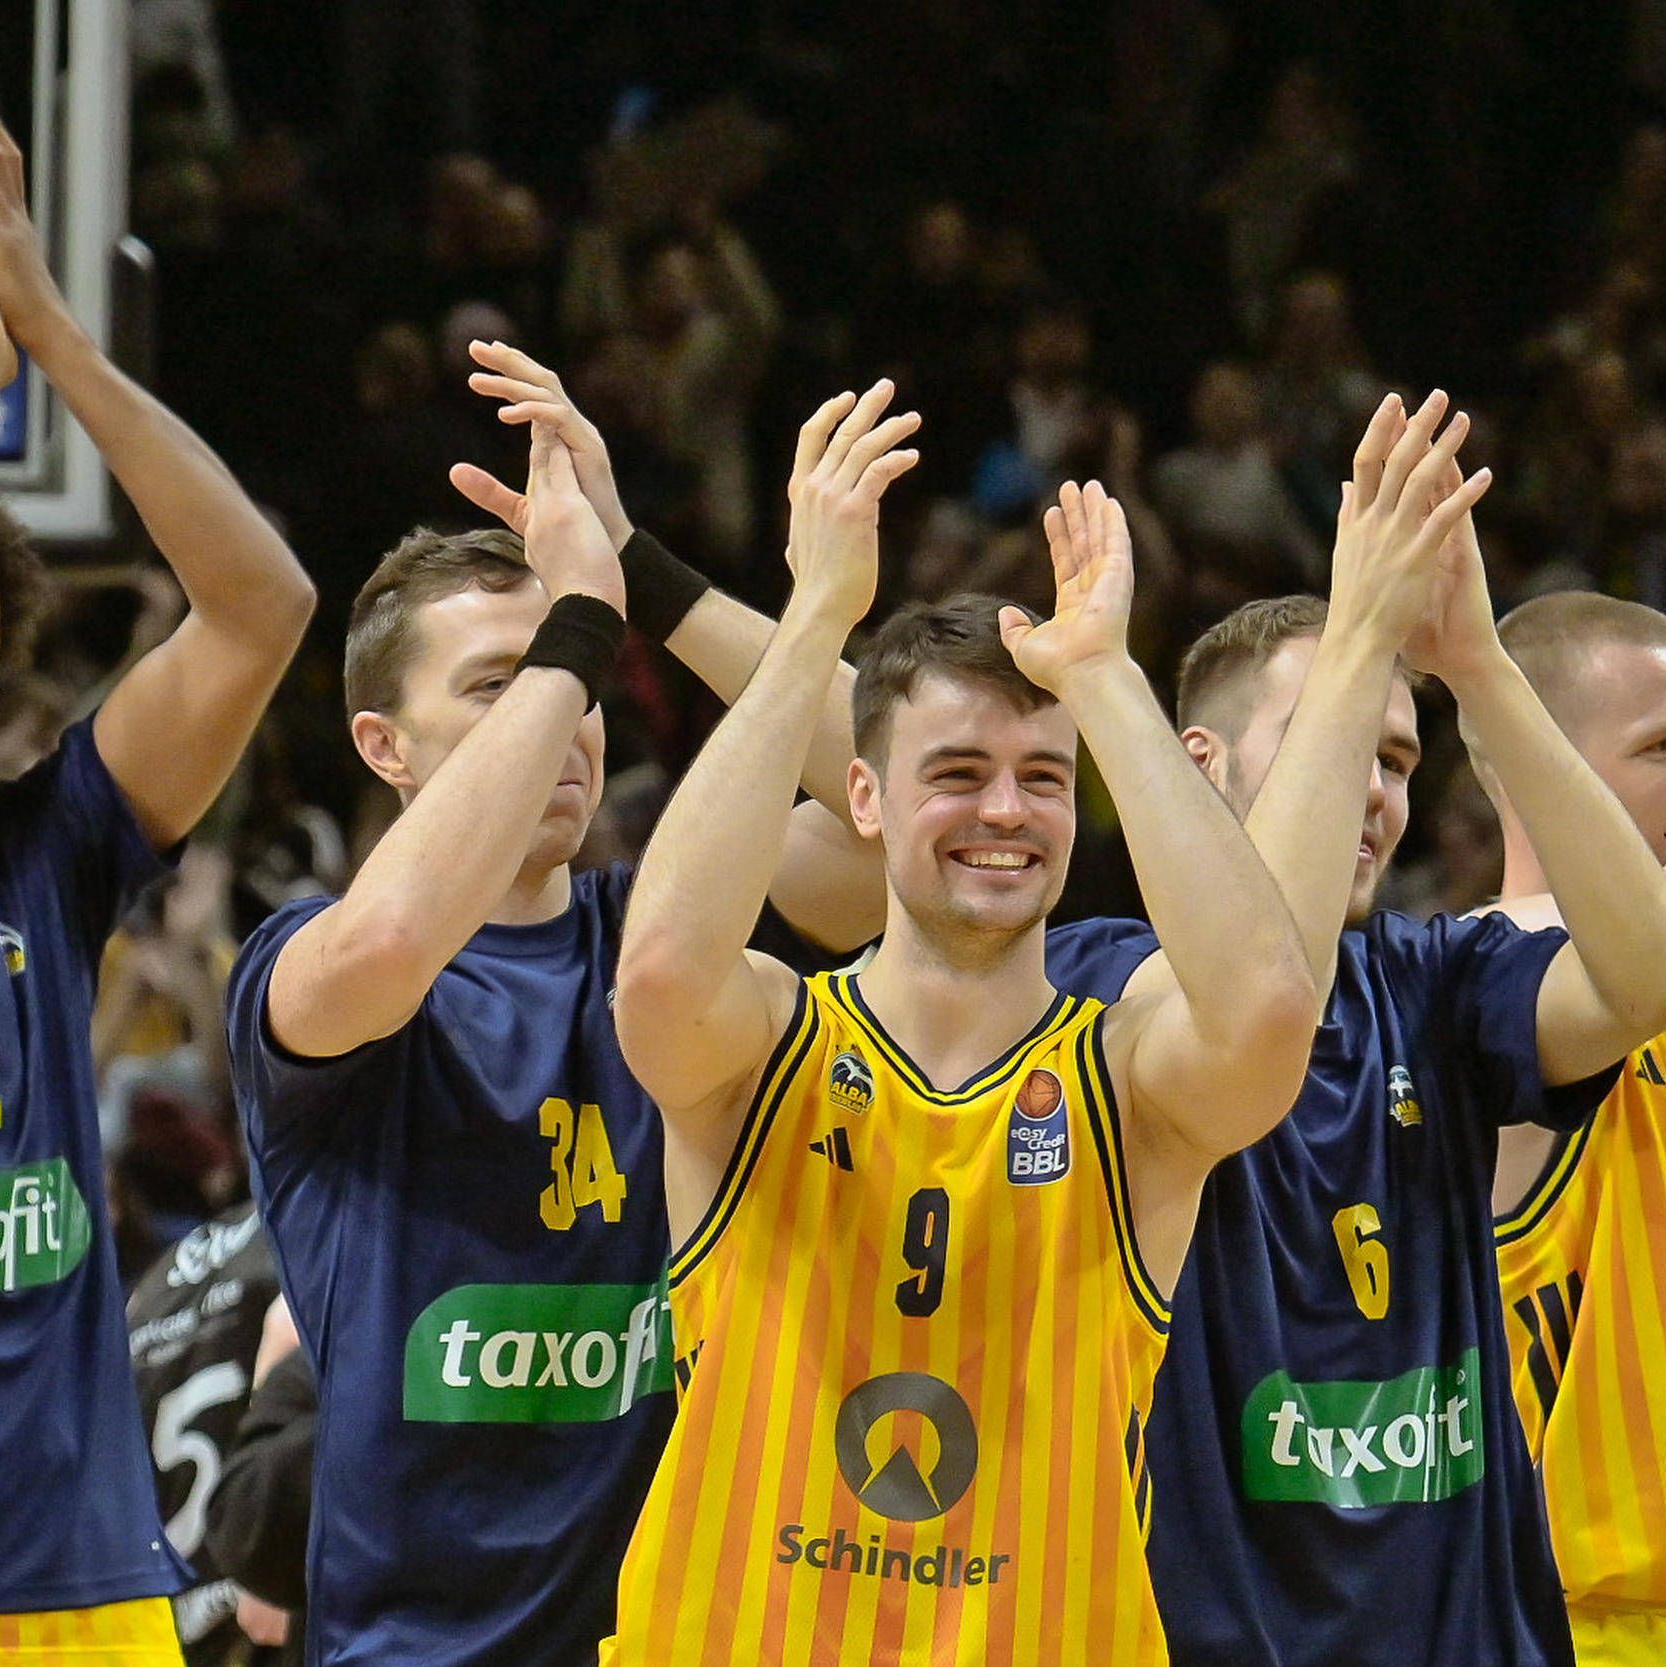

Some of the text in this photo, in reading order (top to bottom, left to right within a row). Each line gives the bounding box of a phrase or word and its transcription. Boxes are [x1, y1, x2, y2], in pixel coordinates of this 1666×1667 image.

[538, 1097, 627, 1230] 34
[1012, 1146, 1066, 1176] BBL
[895, 1187, 950, 1318] 9
[1333, 1203, 1389, 1320] 6
[152, 1360, 248, 1558] 5
[776, 1524, 1010, 1589] Schindler
